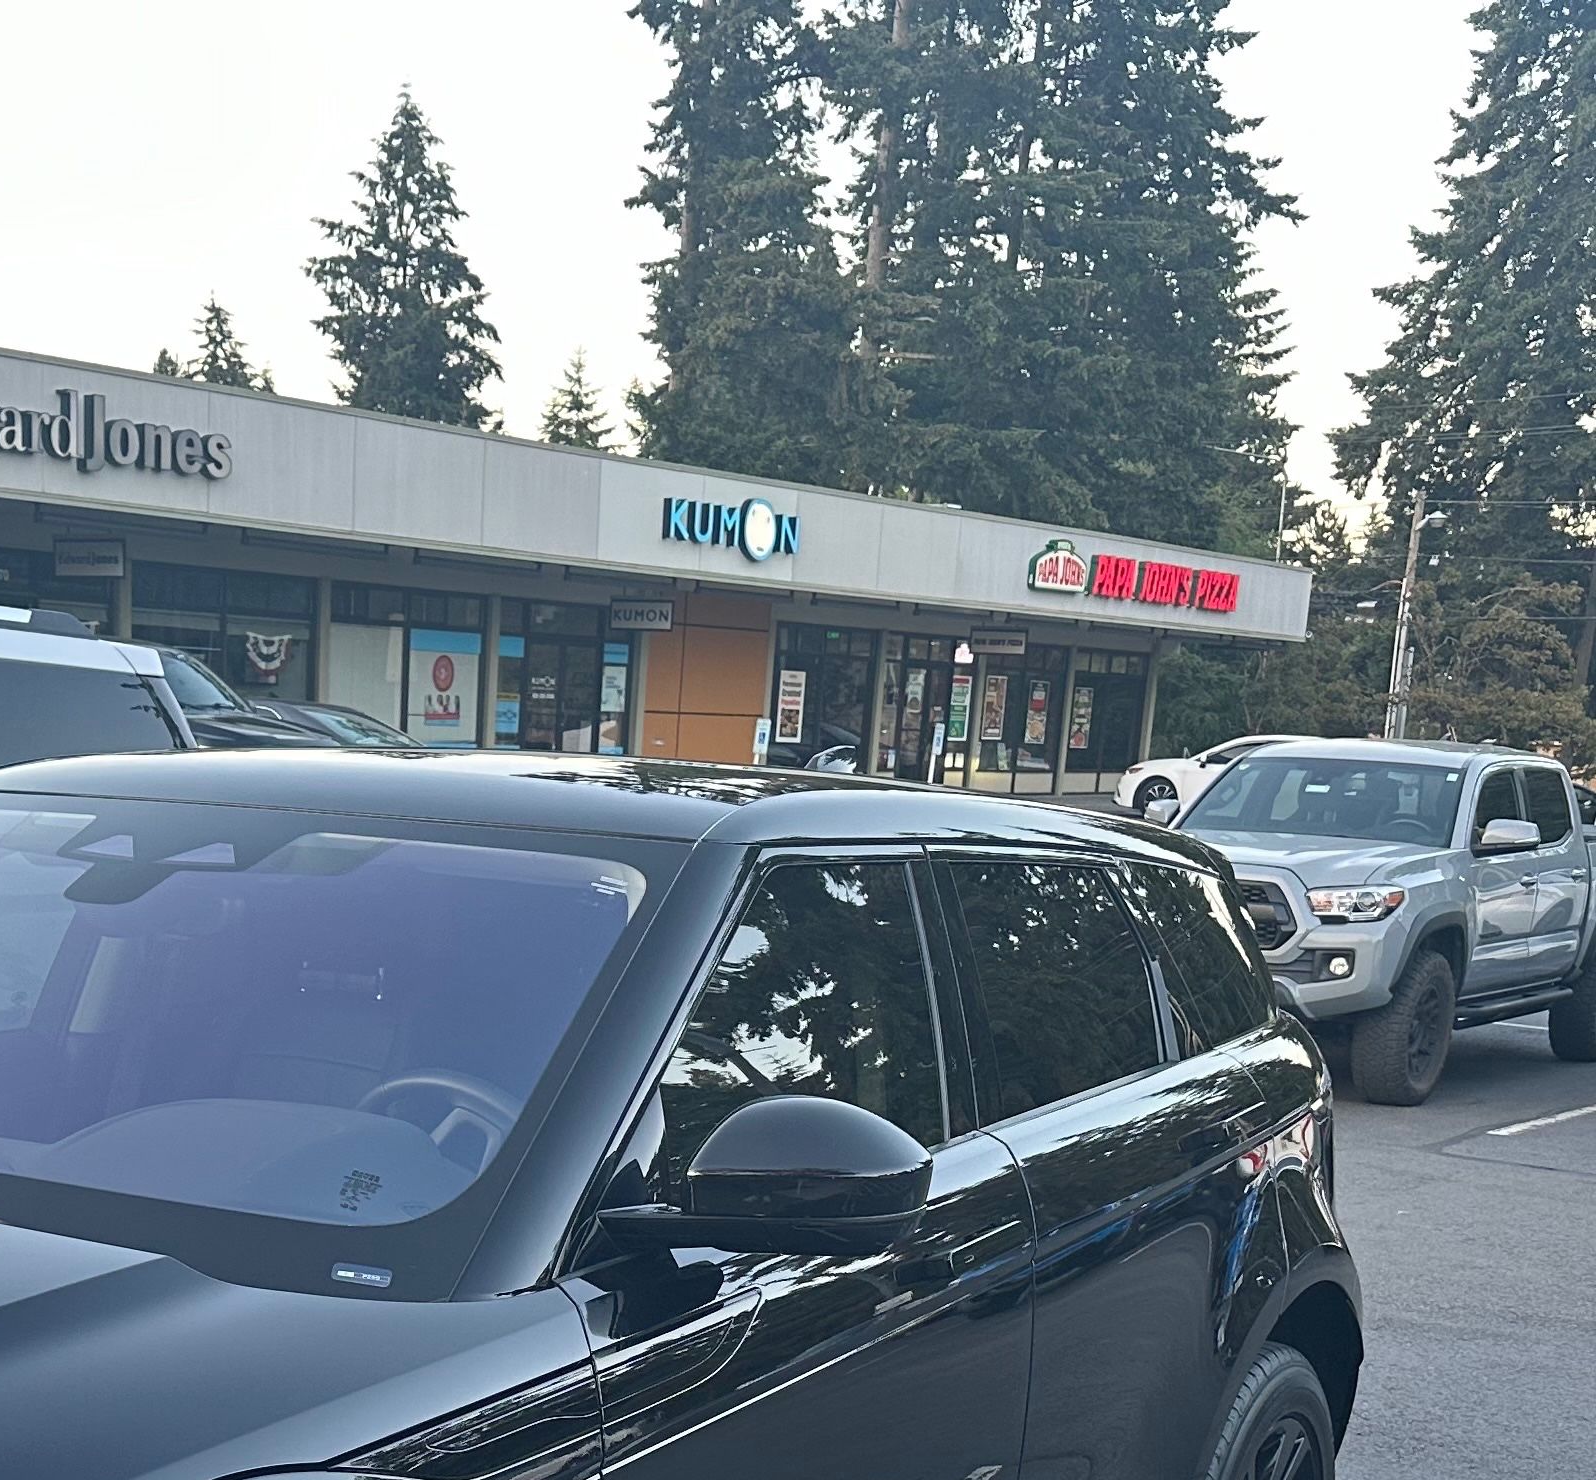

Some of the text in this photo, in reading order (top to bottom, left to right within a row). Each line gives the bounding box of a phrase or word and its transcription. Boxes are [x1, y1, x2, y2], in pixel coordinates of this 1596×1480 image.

[662, 498, 800, 562] KUMON
[1091, 554, 1240, 613] PAPA JOHN'S PIZZA
[612, 608, 669, 623] KUMON
